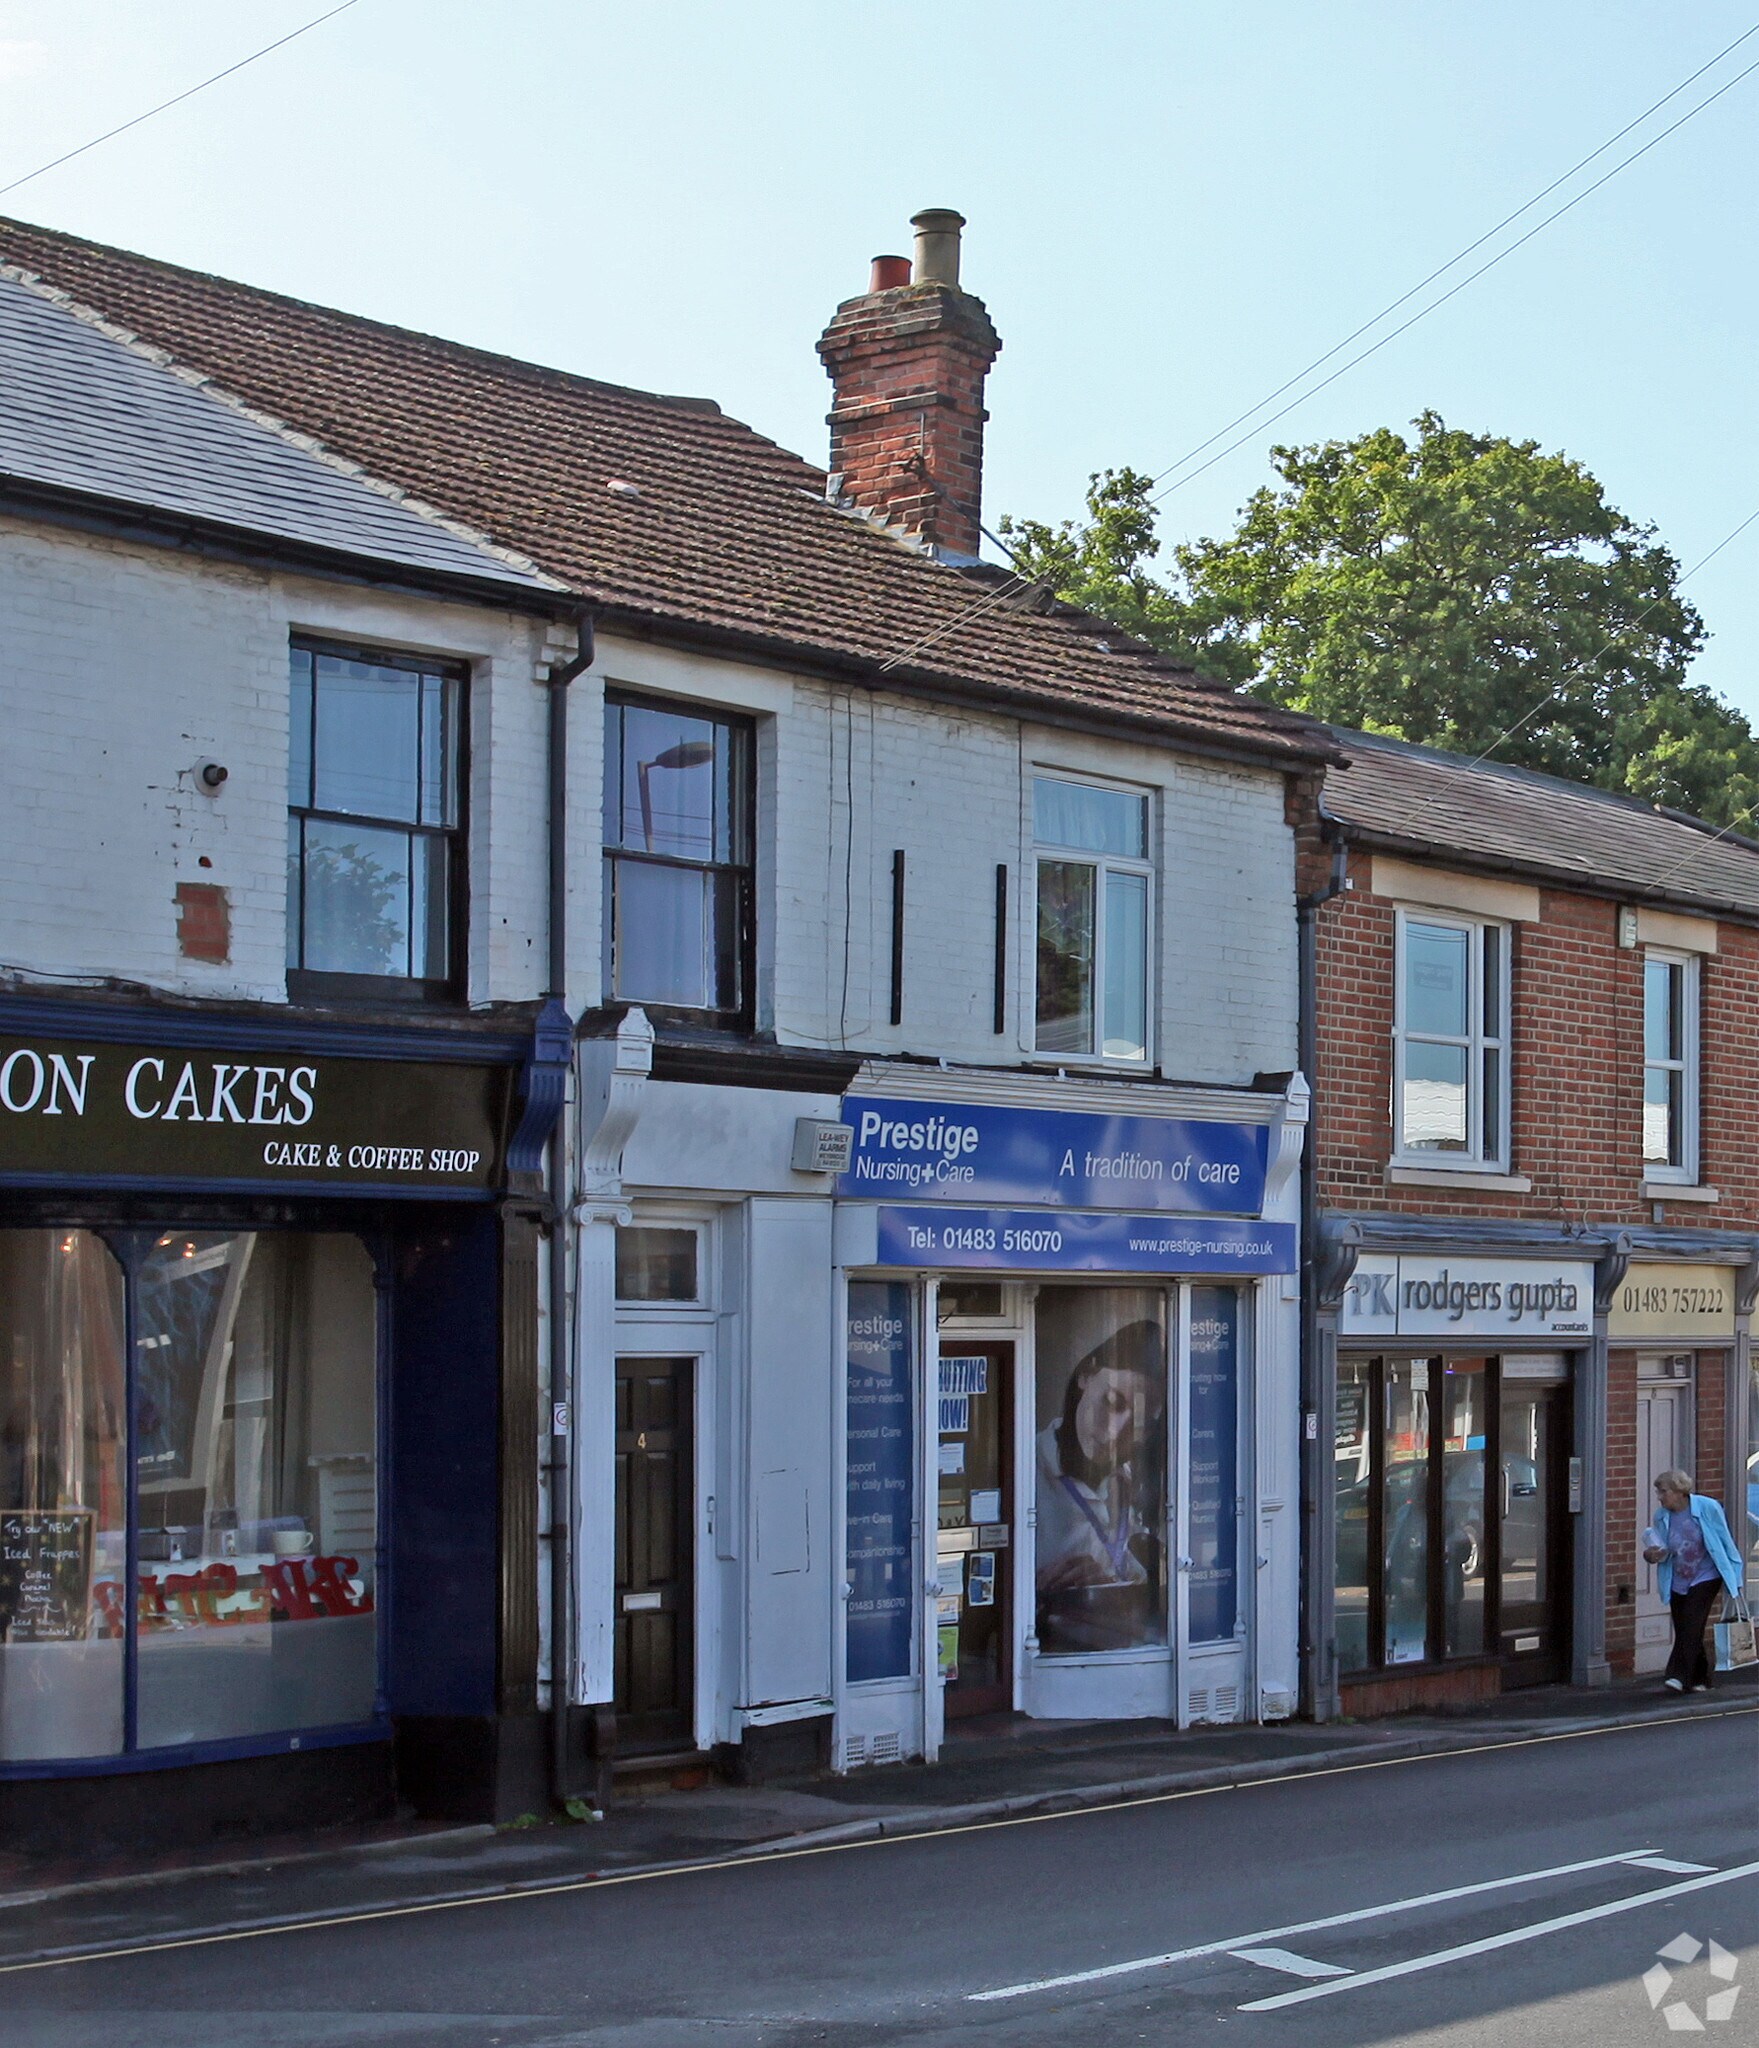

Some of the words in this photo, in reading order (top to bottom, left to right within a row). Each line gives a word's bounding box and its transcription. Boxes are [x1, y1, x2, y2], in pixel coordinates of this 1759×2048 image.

[124, 1057, 318, 1125] CAKES
[859, 1111, 979, 1160] Prestige
[263, 1141, 321, 1166] CAKE
[326, 1144, 342, 1167] &
[347, 1145, 424, 1171] COFFEE
[428, 1149, 480, 1172] SHOP
[1059, 1149, 1076, 1177] A
[1084, 1152, 1163, 1180] tradition
[1171, 1155, 1193, 1182] of
[1198, 1161, 1240, 1184] care
[907, 1227, 937, 1249] Tel:
[943, 1227, 996, 1250] 01483
[1003, 1230, 1062, 1252] 516070
[1129, 1237, 1273, 1258] www.prestige-nursing.co.uk
[1403, 1269, 1501, 1321] rodgers
[1506, 1277, 1577, 1321] gupta
[1624, 1286, 1667, 1313] 01483
[1672, 1287, 1723, 1313] 757222
[637, 1432, 647, 1450] 4
[3, 1546, 32, 1560] Iced
